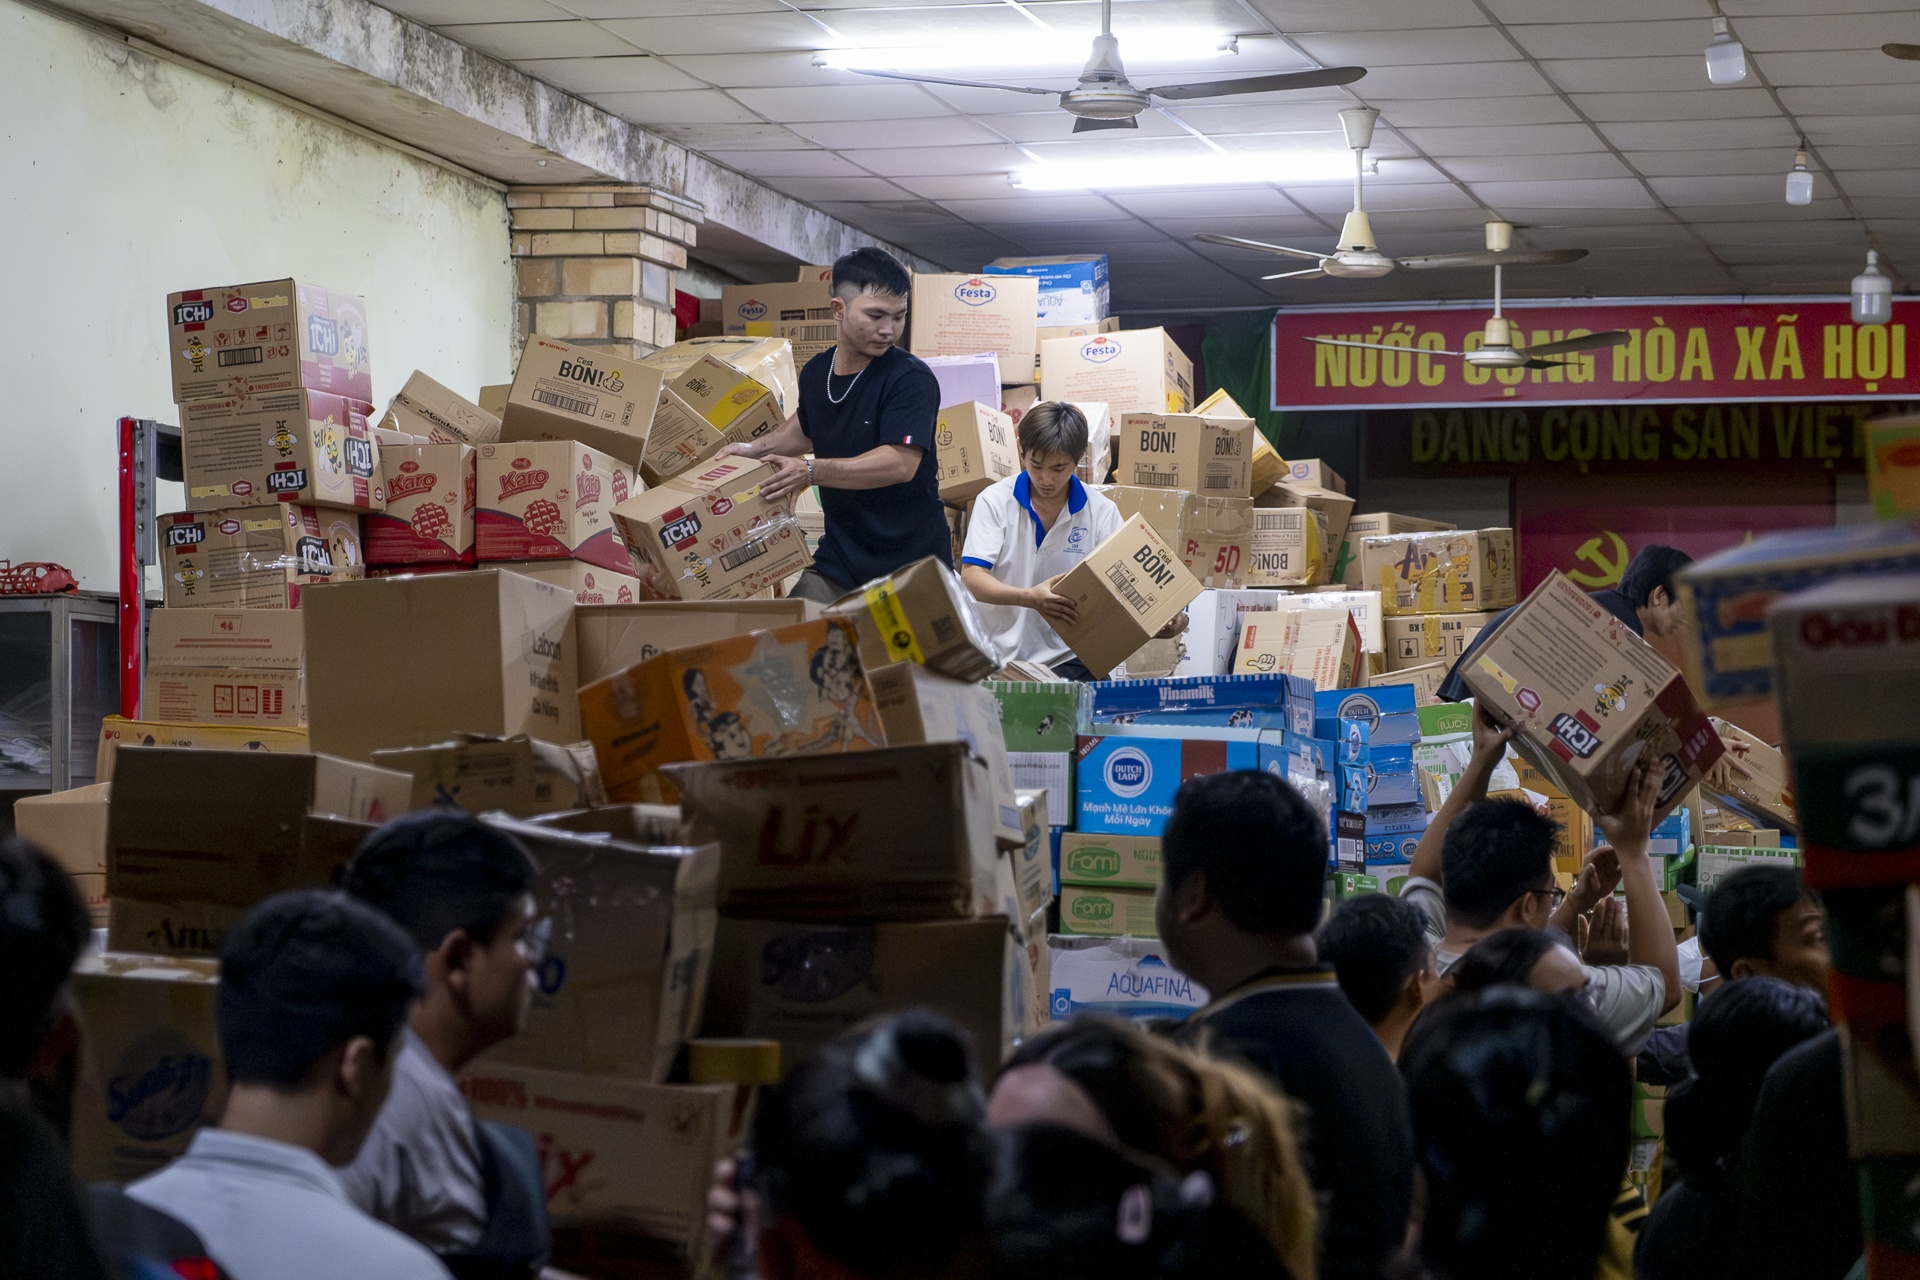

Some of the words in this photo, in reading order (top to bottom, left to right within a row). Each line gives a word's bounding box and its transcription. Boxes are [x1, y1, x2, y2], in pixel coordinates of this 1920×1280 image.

[1314, 322, 1446, 388] NƯỚC
[1612, 316, 1715, 383] HÒA
[1733, 313, 1806, 381] XÃ
[558, 360, 605, 388] BON!
[987, 421, 1008, 448] BON!
[1140, 430, 1176, 454] BON!
[1215, 437, 1235, 456] BON!
[388, 473, 437, 496] Karo
[499, 469, 549, 492] Karo
[576, 471, 601, 497] Karo
[1133, 544, 1175, 590] BON!
[1157, 548, 1172, 565] C'est
[1257, 553, 1288, 570] BON!
[532, 629, 561, 661] Labon
[1159, 685, 1215, 701] Vinamilk
[1114, 765, 1142, 774] DUTCH
[1117, 772, 1139, 782] LADY
[1083, 801, 1111, 815] Mạnh
[1129, 802, 1147, 814] Lớn
[1124, 814, 1151, 827] Ngày
[757, 803, 859, 866] Lix
[1070, 851, 1118, 871] Fami
[1074, 901, 1112, 915] Fami
[1106, 972, 1194, 1001] AQUAFINA
